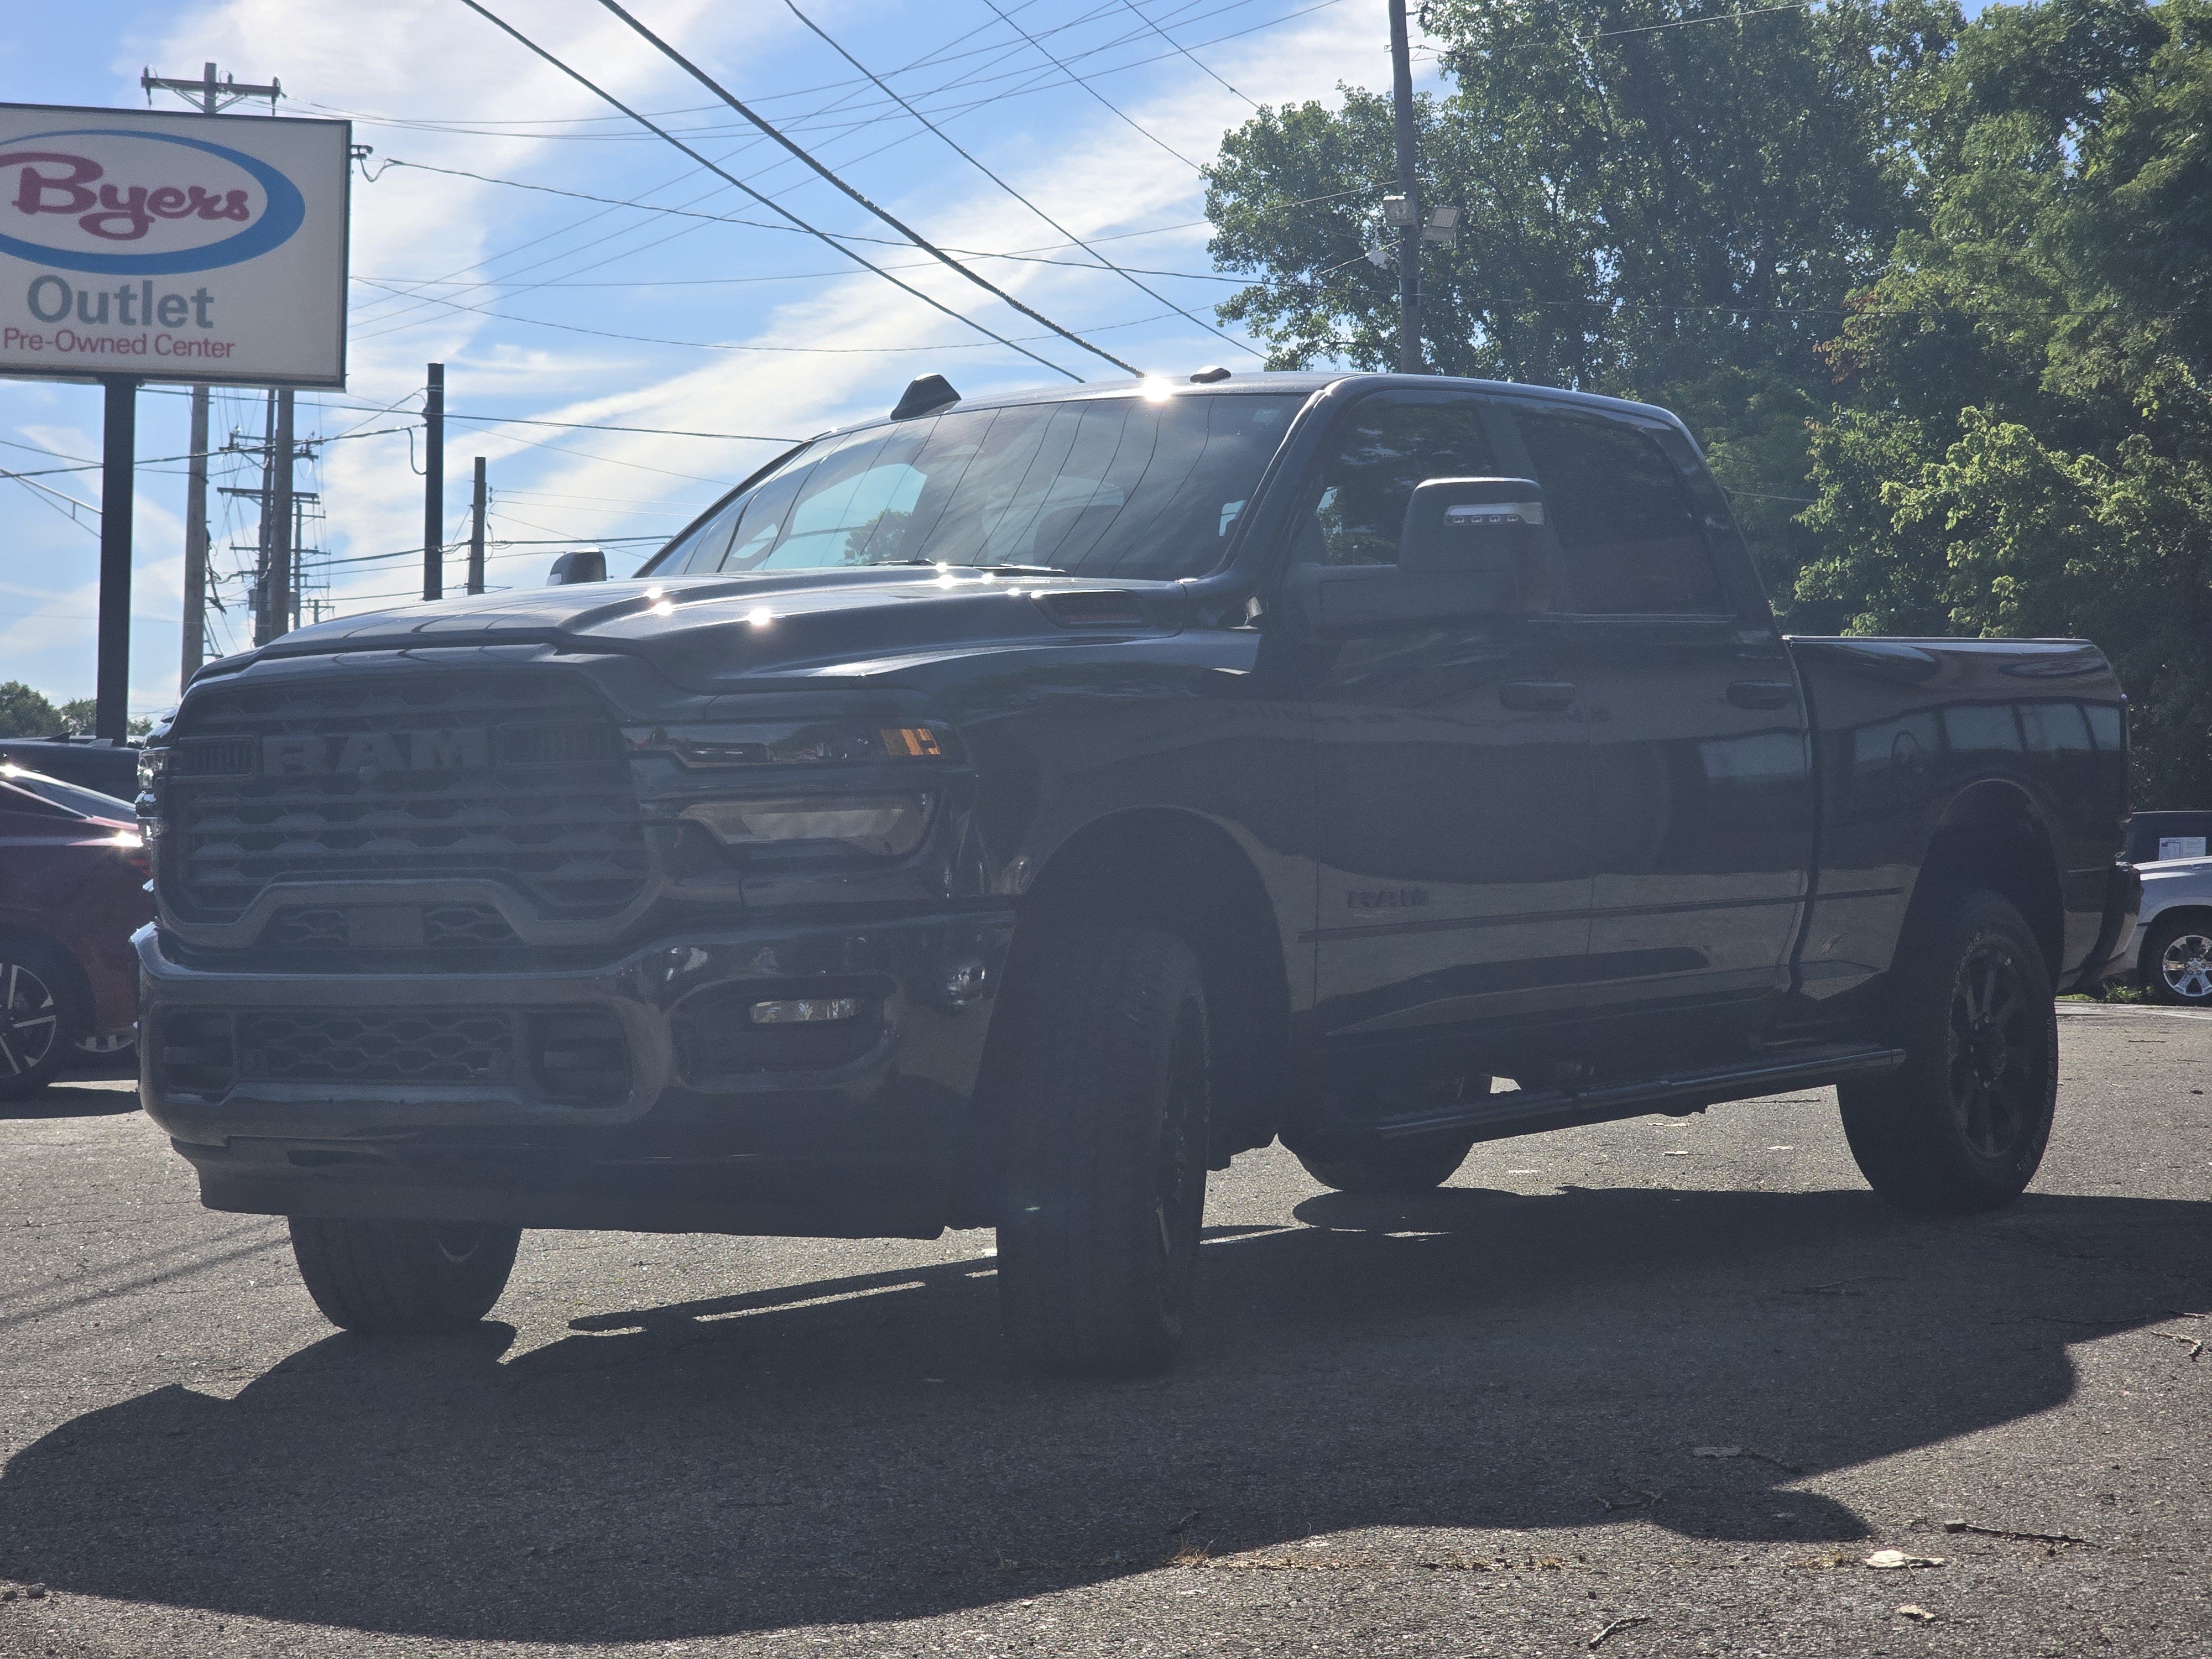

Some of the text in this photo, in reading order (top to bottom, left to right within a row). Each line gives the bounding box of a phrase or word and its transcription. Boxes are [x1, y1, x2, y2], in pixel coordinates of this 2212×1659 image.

[0, 153, 250, 241] Byers
[28, 275, 215, 328] Outlet
[3, 327, 235, 358] Pre-Owned Center
[262, 728, 489, 775] RAM
[1347, 888, 1430, 908] RAM
